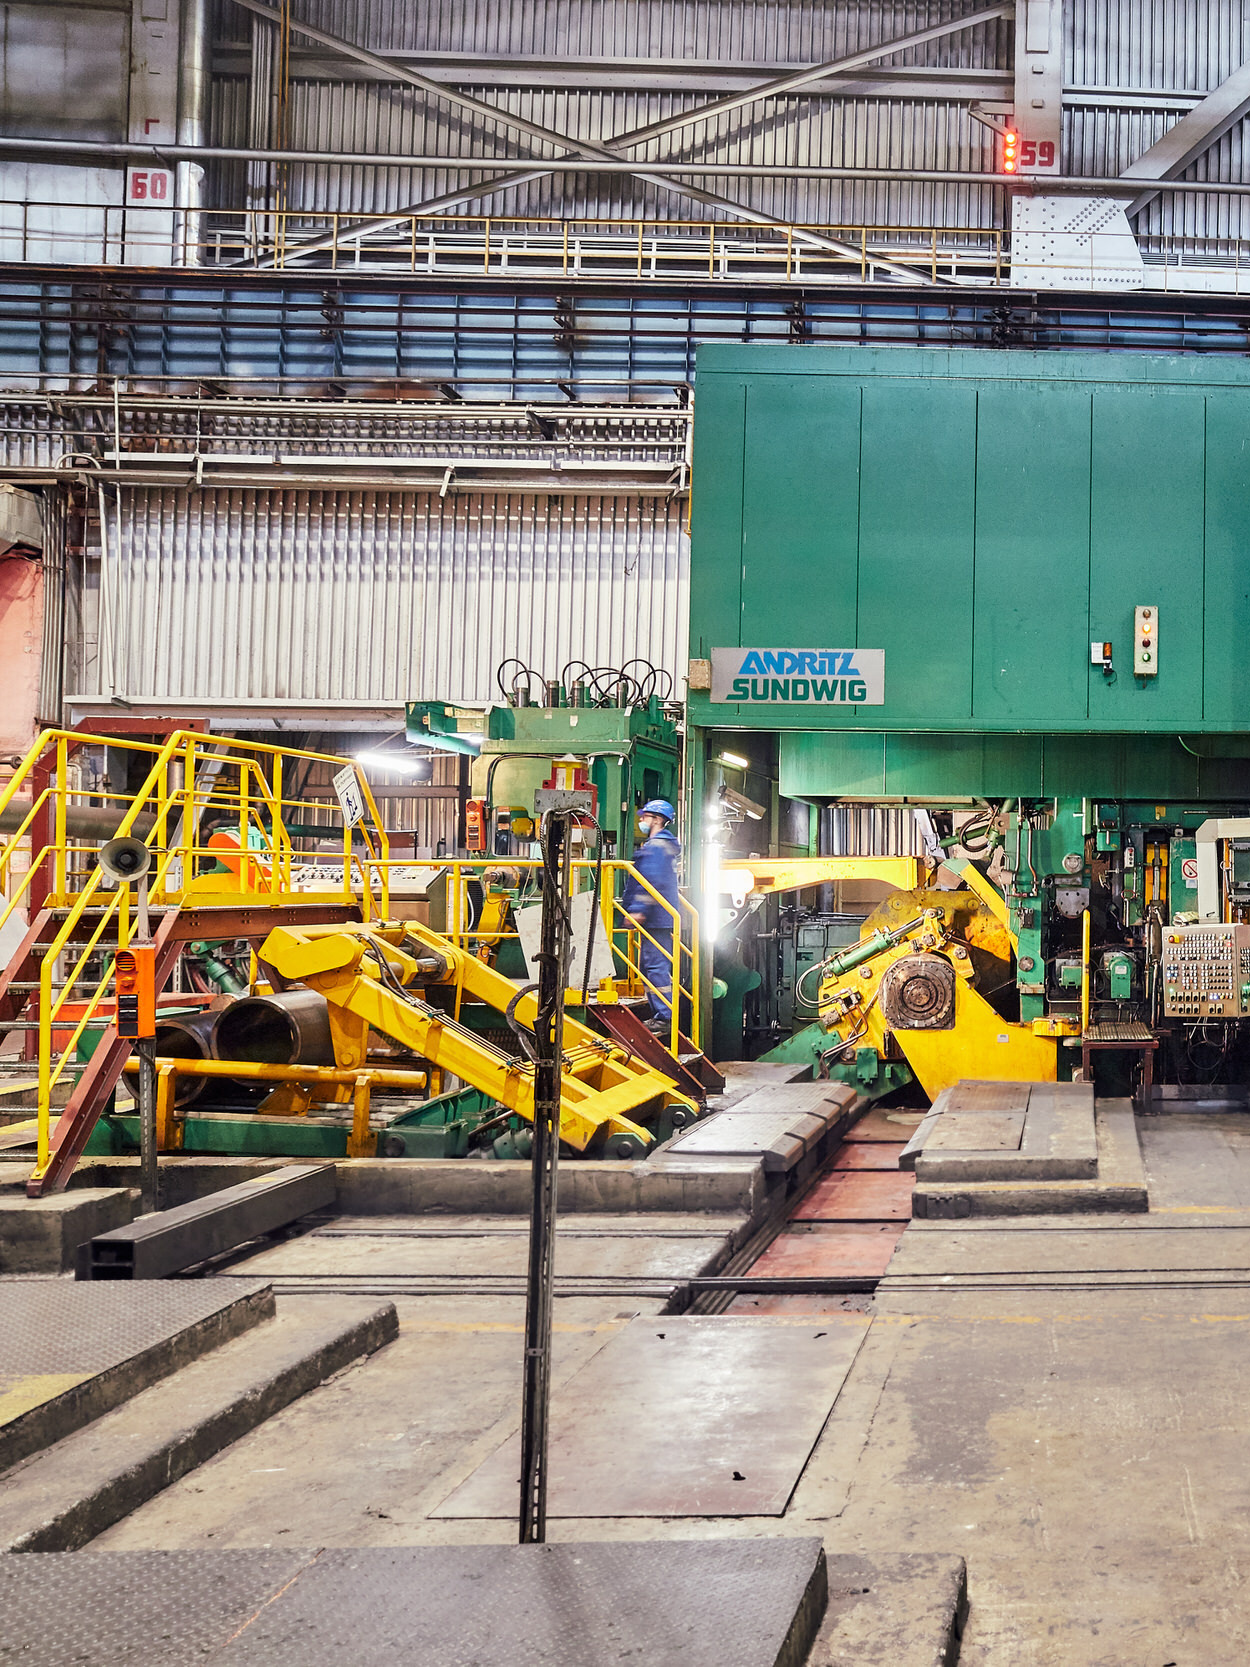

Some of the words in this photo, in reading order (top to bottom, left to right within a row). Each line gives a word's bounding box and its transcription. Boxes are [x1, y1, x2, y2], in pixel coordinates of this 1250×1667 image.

[1020, 141, 1055, 167] 59
[738, 651, 861, 676] ANDRITZ
[726, 678, 867, 702] SUNDWIG
